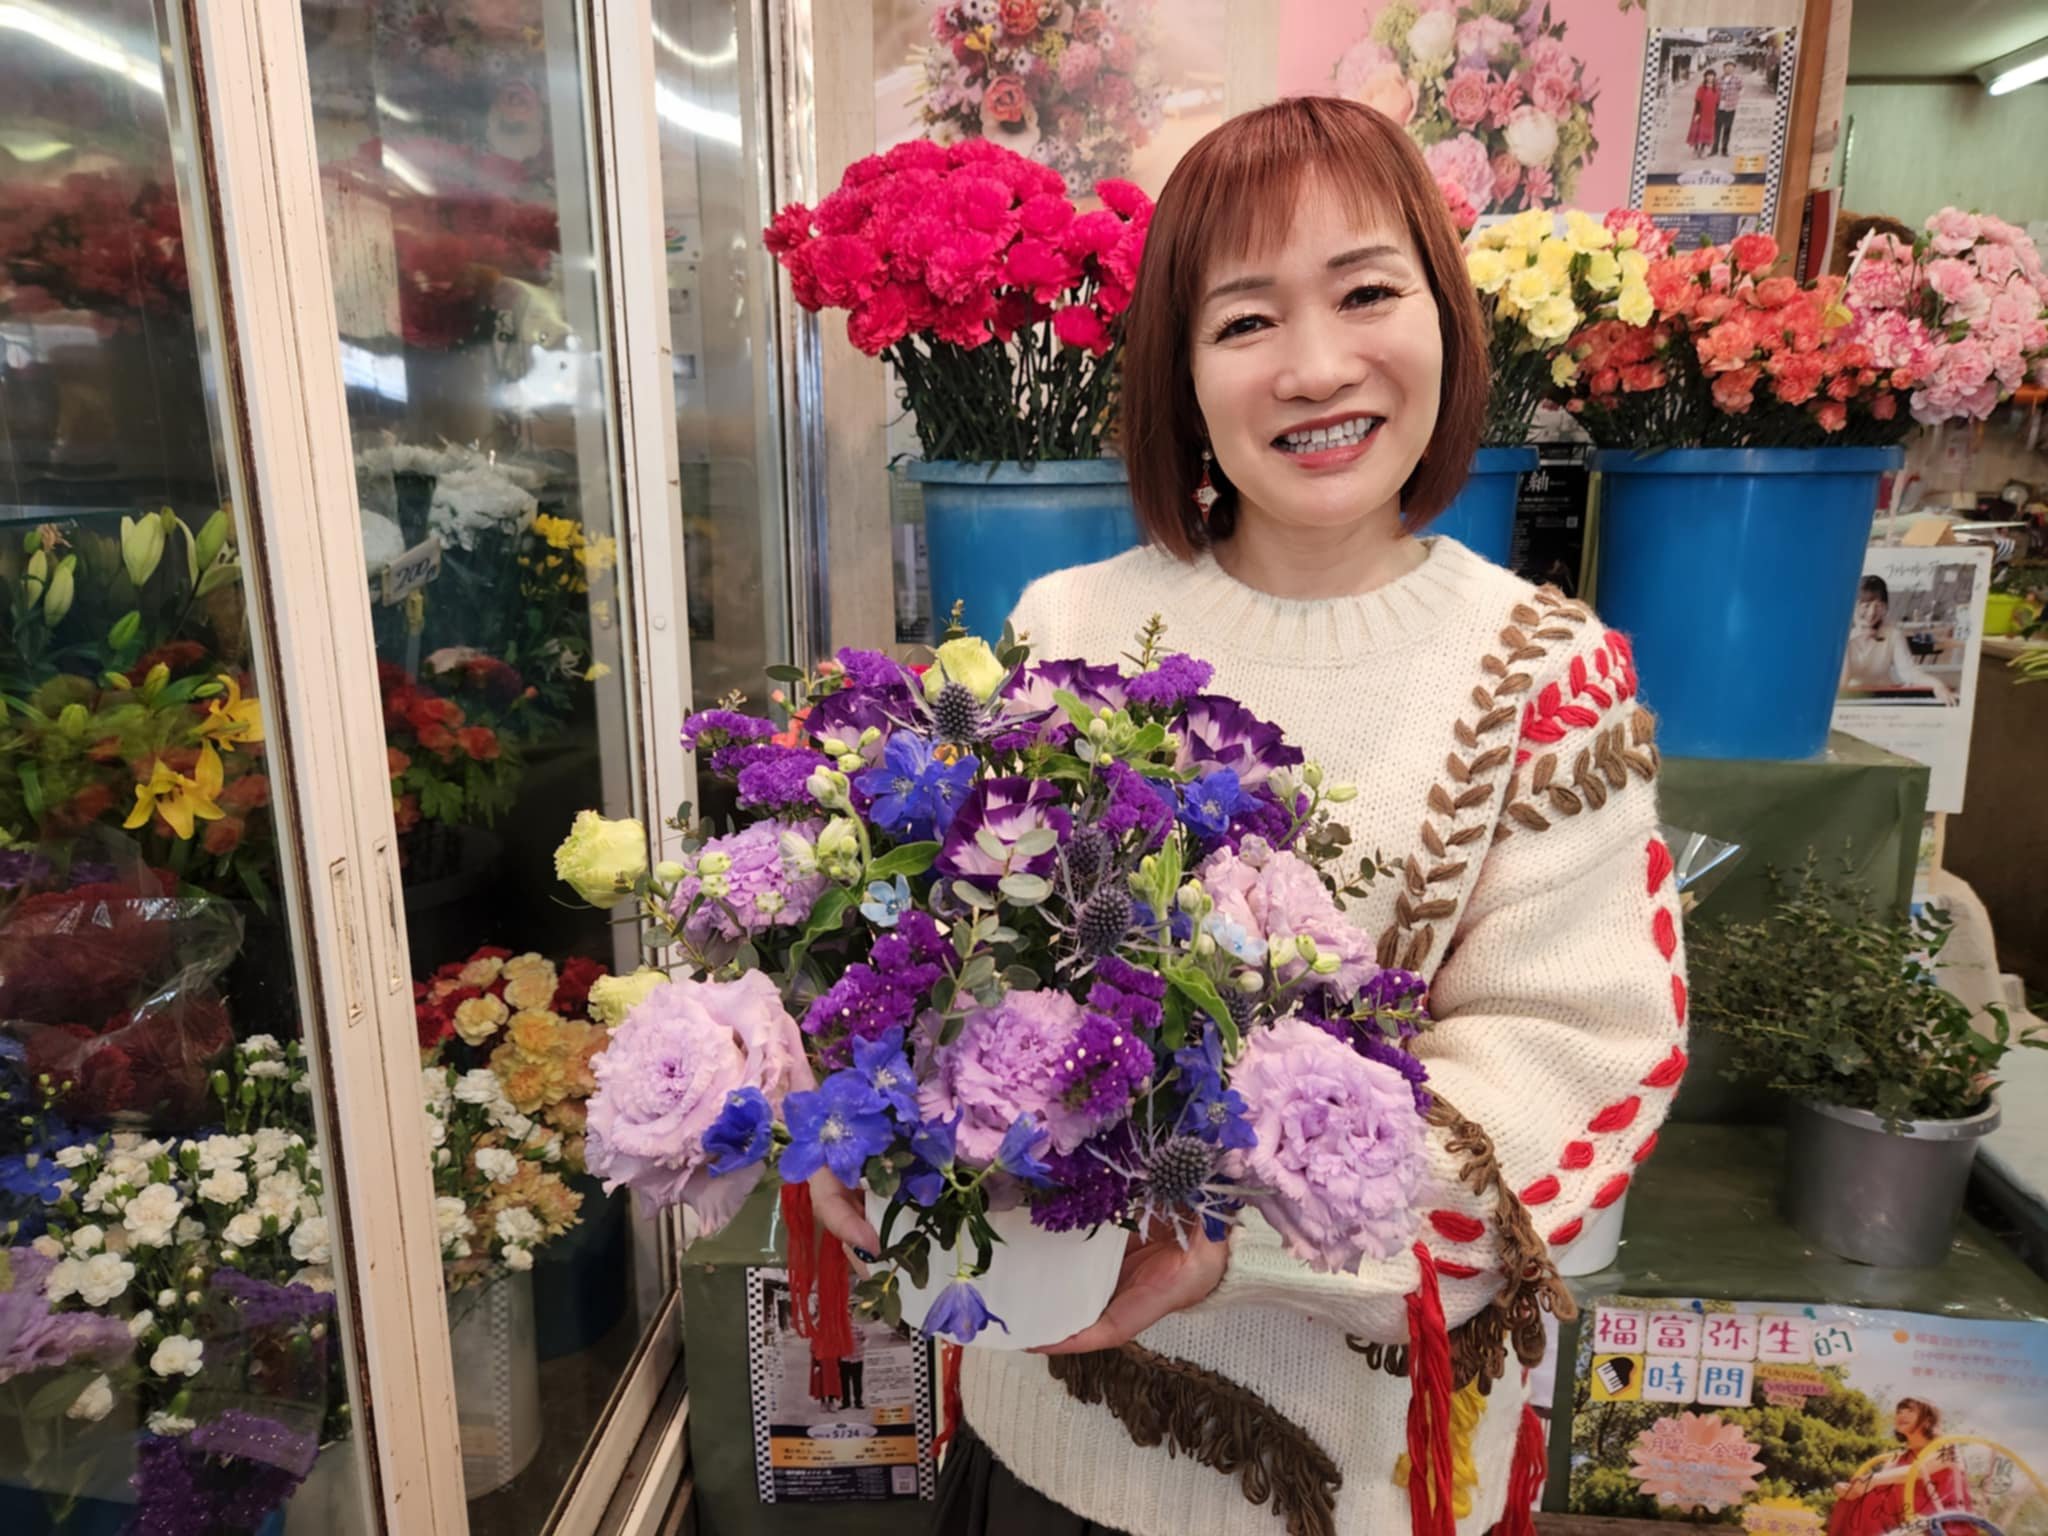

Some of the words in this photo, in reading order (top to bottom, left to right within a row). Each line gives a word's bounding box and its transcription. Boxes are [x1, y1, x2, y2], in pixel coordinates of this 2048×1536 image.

[1599, 1312, 1853, 1357] 福富弥生的
[1648, 1361, 1744, 1399] 時間
